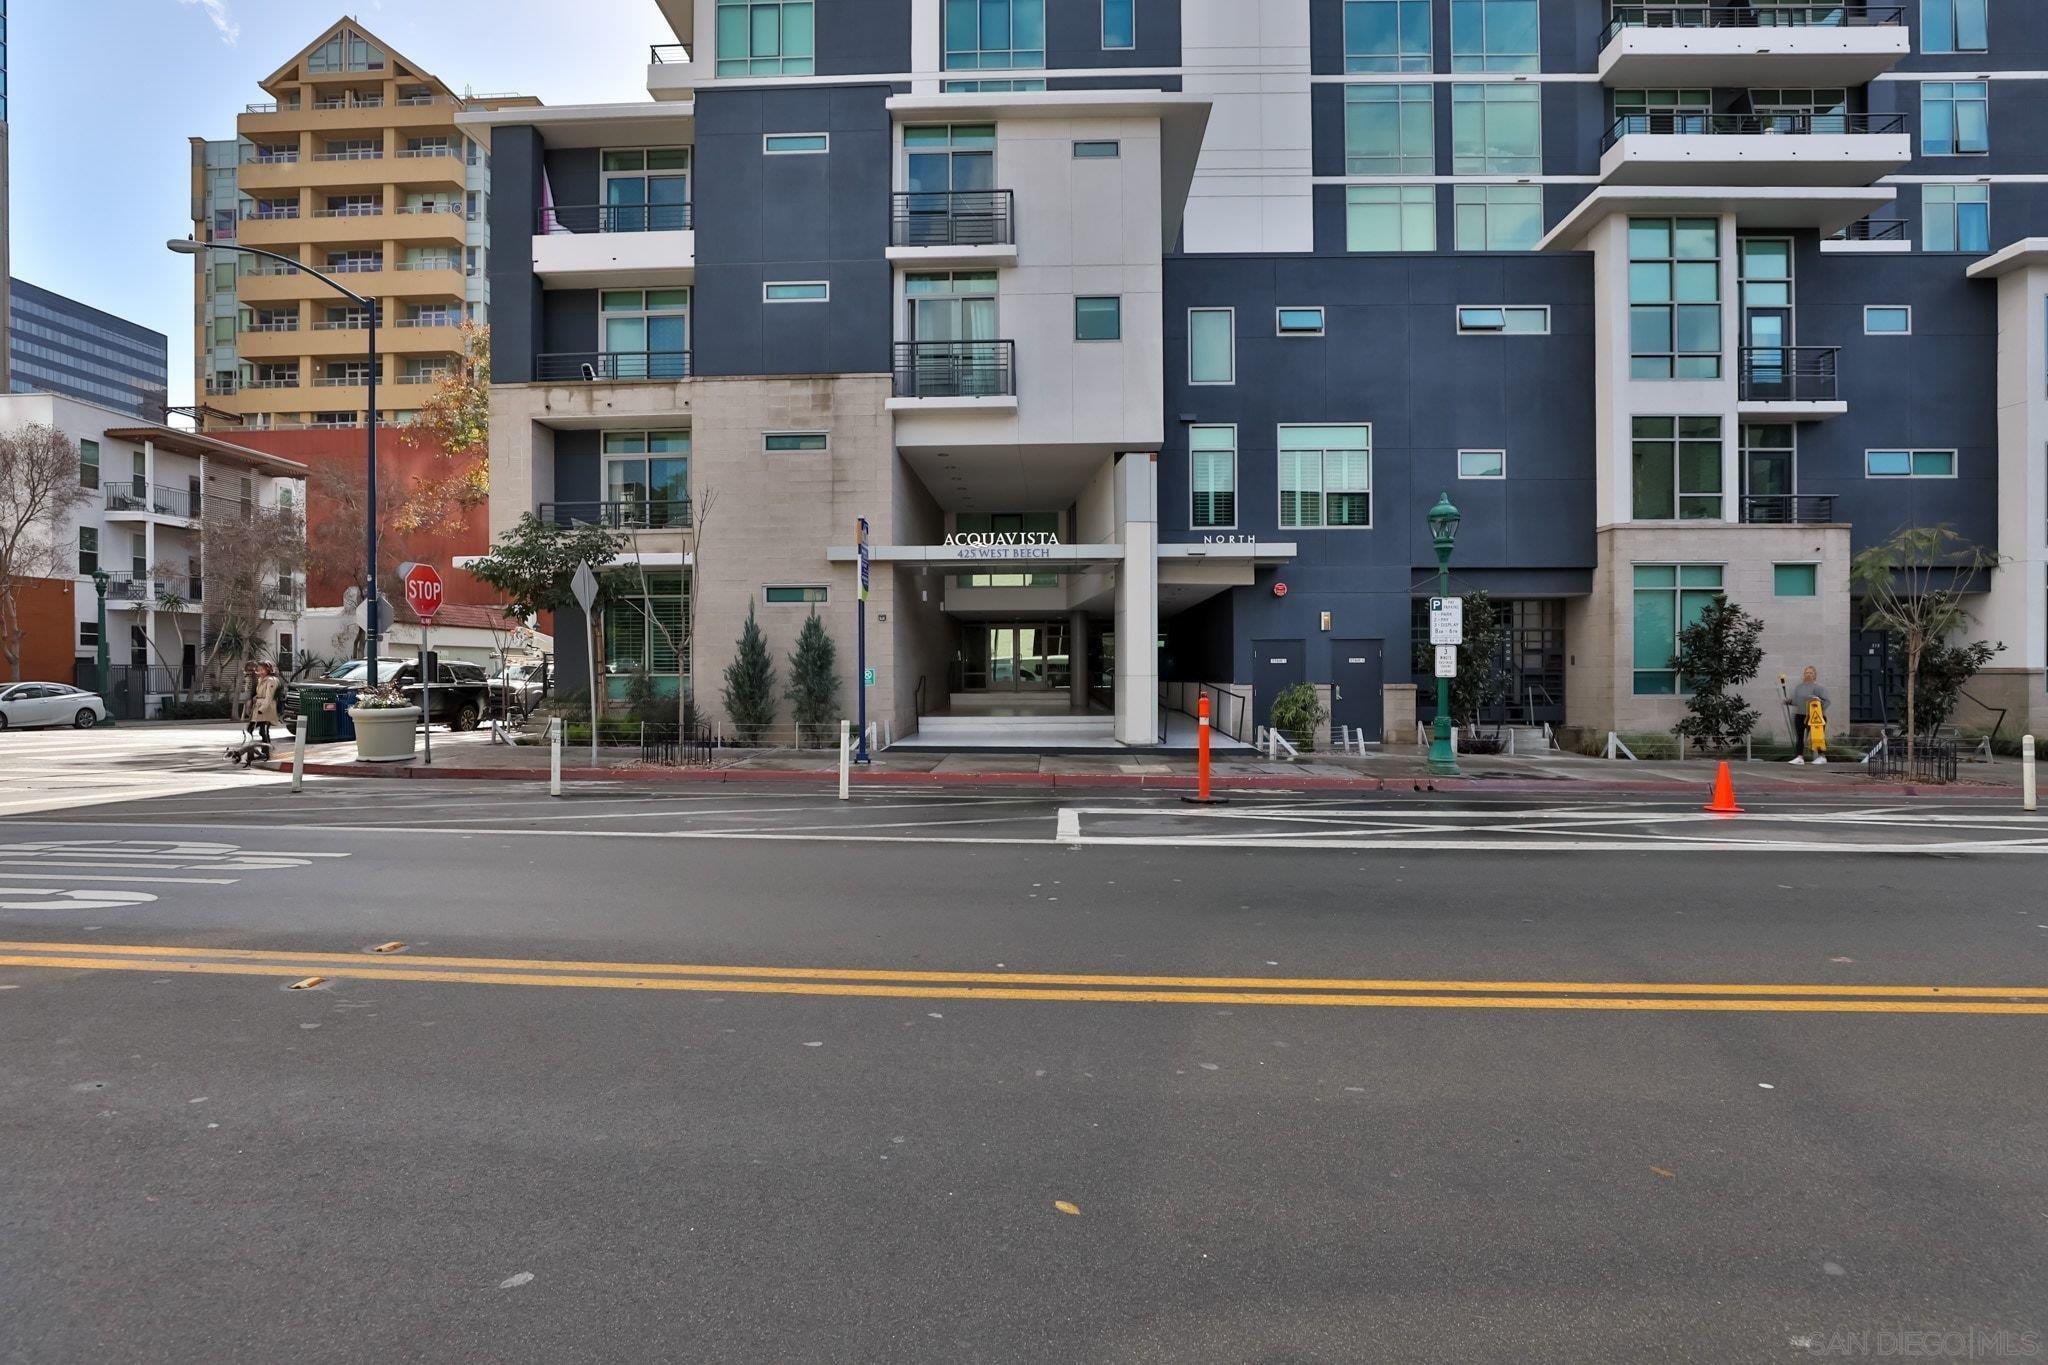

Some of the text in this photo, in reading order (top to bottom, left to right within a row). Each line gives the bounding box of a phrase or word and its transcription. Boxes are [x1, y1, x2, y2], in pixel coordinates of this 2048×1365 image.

[943, 532, 1060, 548] ACQUAVISTA
[1204, 534, 1255, 544] NORTH
[958, 548, 1050, 558] 425 WEST BEECH
[409, 580, 440, 600] STOP
[1433, 601, 1441, 610] P
